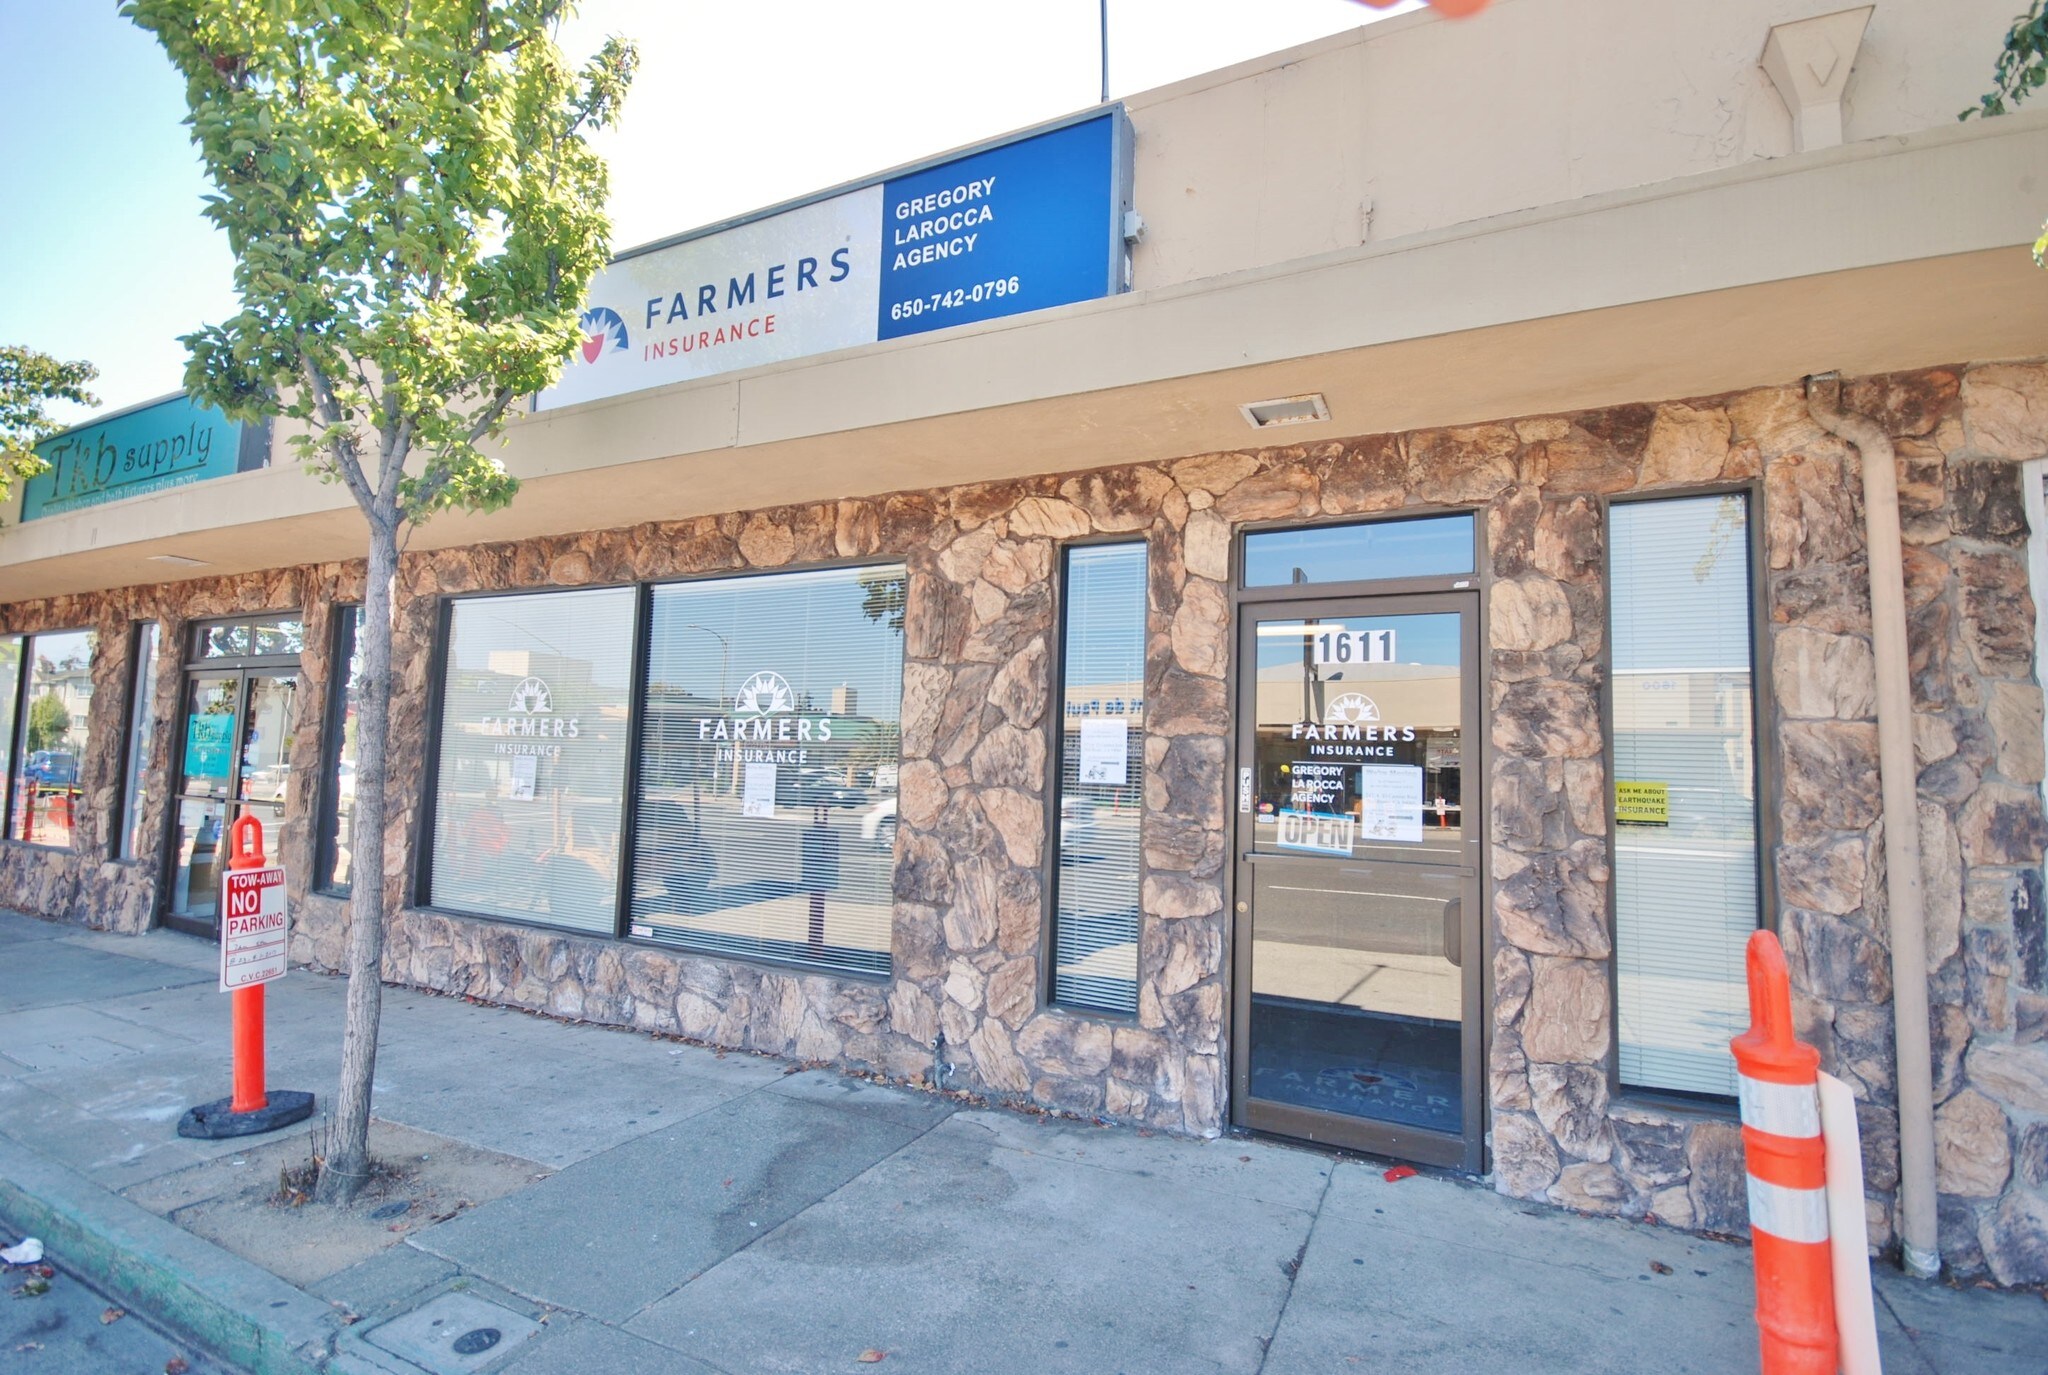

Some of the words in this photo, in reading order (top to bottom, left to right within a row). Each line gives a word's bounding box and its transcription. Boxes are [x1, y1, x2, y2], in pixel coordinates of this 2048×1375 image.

[896, 176, 996, 221] GREGORY
[895, 204, 993, 246] LAROCCA
[893, 234, 978, 271] AGENCY
[645, 247, 851, 330] FARMERS
[891, 276, 1019, 321] 650-742-0796
[644, 314, 776, 362] INSURANCE
[123, 421, 213, 474] supply
[1319, 631, 1391, 663] 1611
[481, 716, 579, 738] FARMERS
[699, 718, 832, 742] FARMERS
[1292, 724, 1415, 742] FARMERS
[494, 743, 561, 757] INSURANCE
[718, 749, 808, 764] INSURANCE
[1310, 745, 1394, 757] INSURANCE
[1292, 765, 1343, 776] GREGORY
[1291, 793, 1335, 804] AGENCY
[1618, 806, 1666, 815] INSURANCE
[1284, 815, 1348, 850] OPEN
[231, 868, 283, 890] TOW-AWAY
[231, 889, 258, 915] NO
[229, 912, 283, 935] PARKING
[1254, 1067, 1452, 1108] FARMER
[1285, 1084, 1445, 1115] INSURANCE
